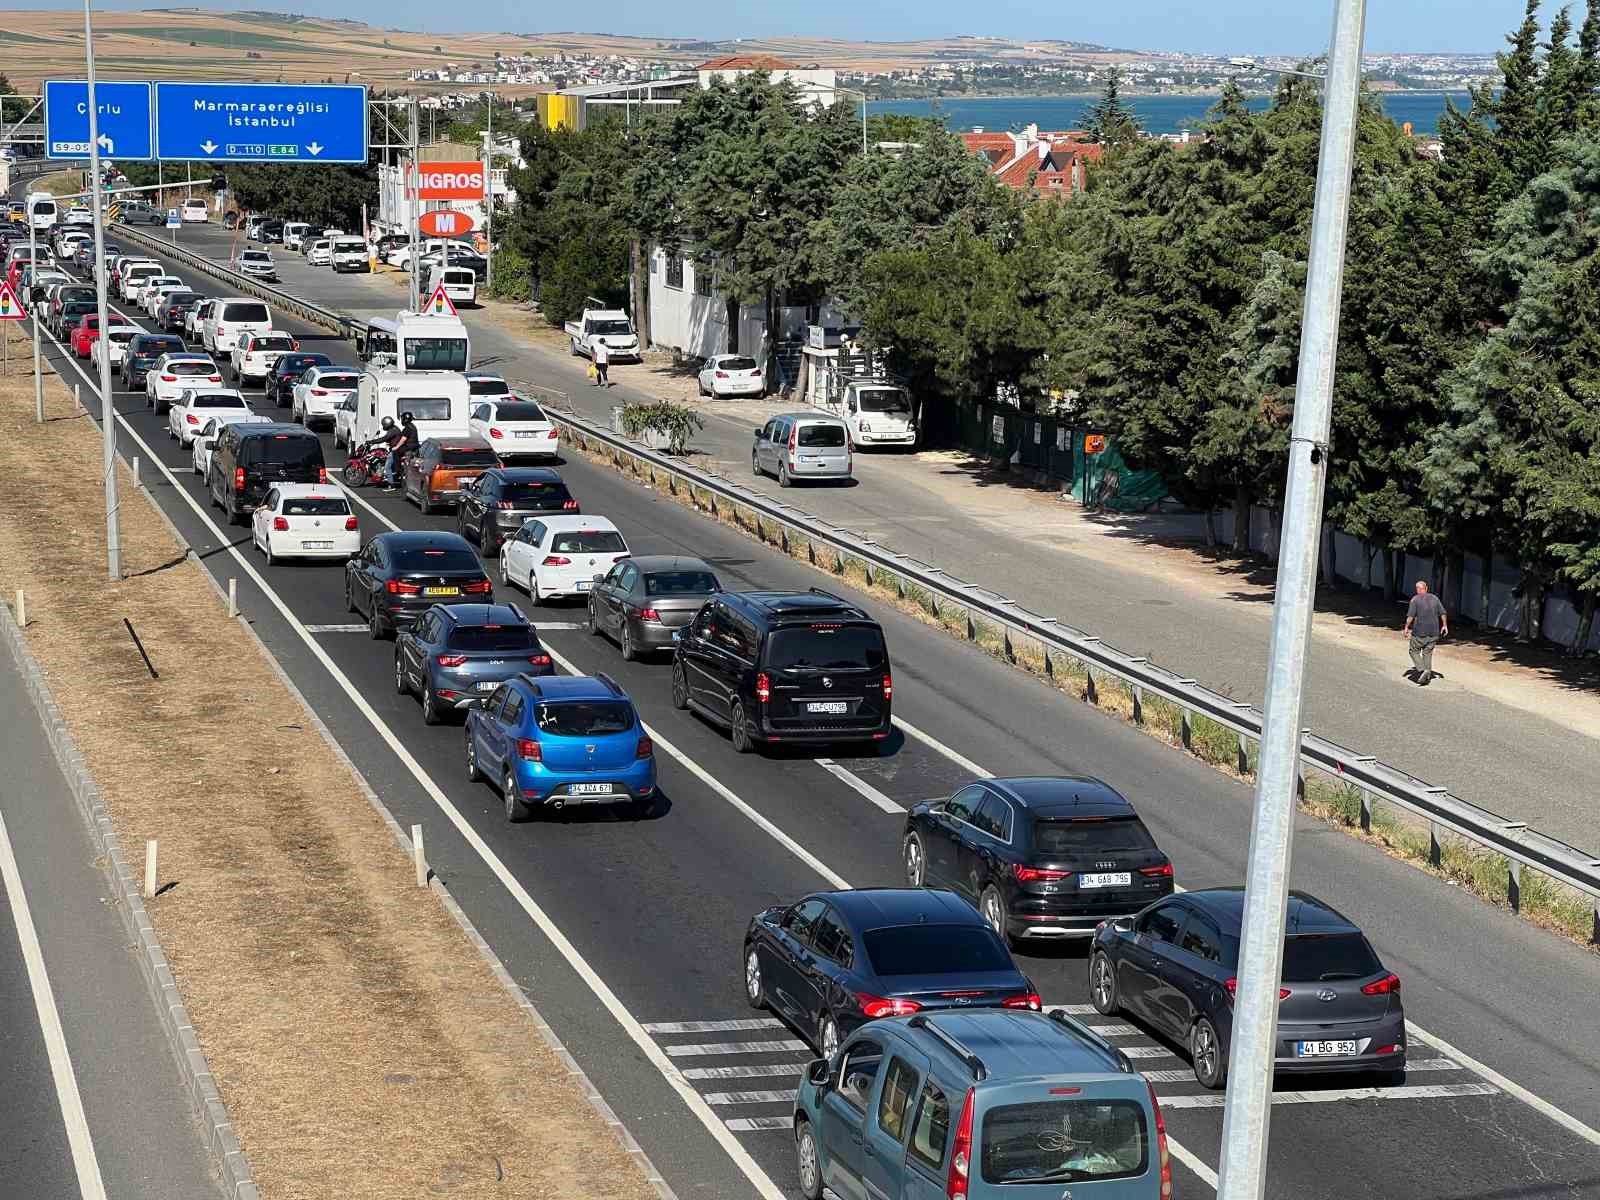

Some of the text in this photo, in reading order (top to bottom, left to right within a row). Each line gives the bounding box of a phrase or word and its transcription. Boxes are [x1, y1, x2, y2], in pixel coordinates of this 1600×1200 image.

[77, 102, 121, 115] Çrlu
[194, 99, 329, 115] Marmaraereğlisi
[228, 112, 295, 127] İstanbul
[435, 213, 455, 233] M
[1304, 1041, 1355, 1053] 41 BG 952
